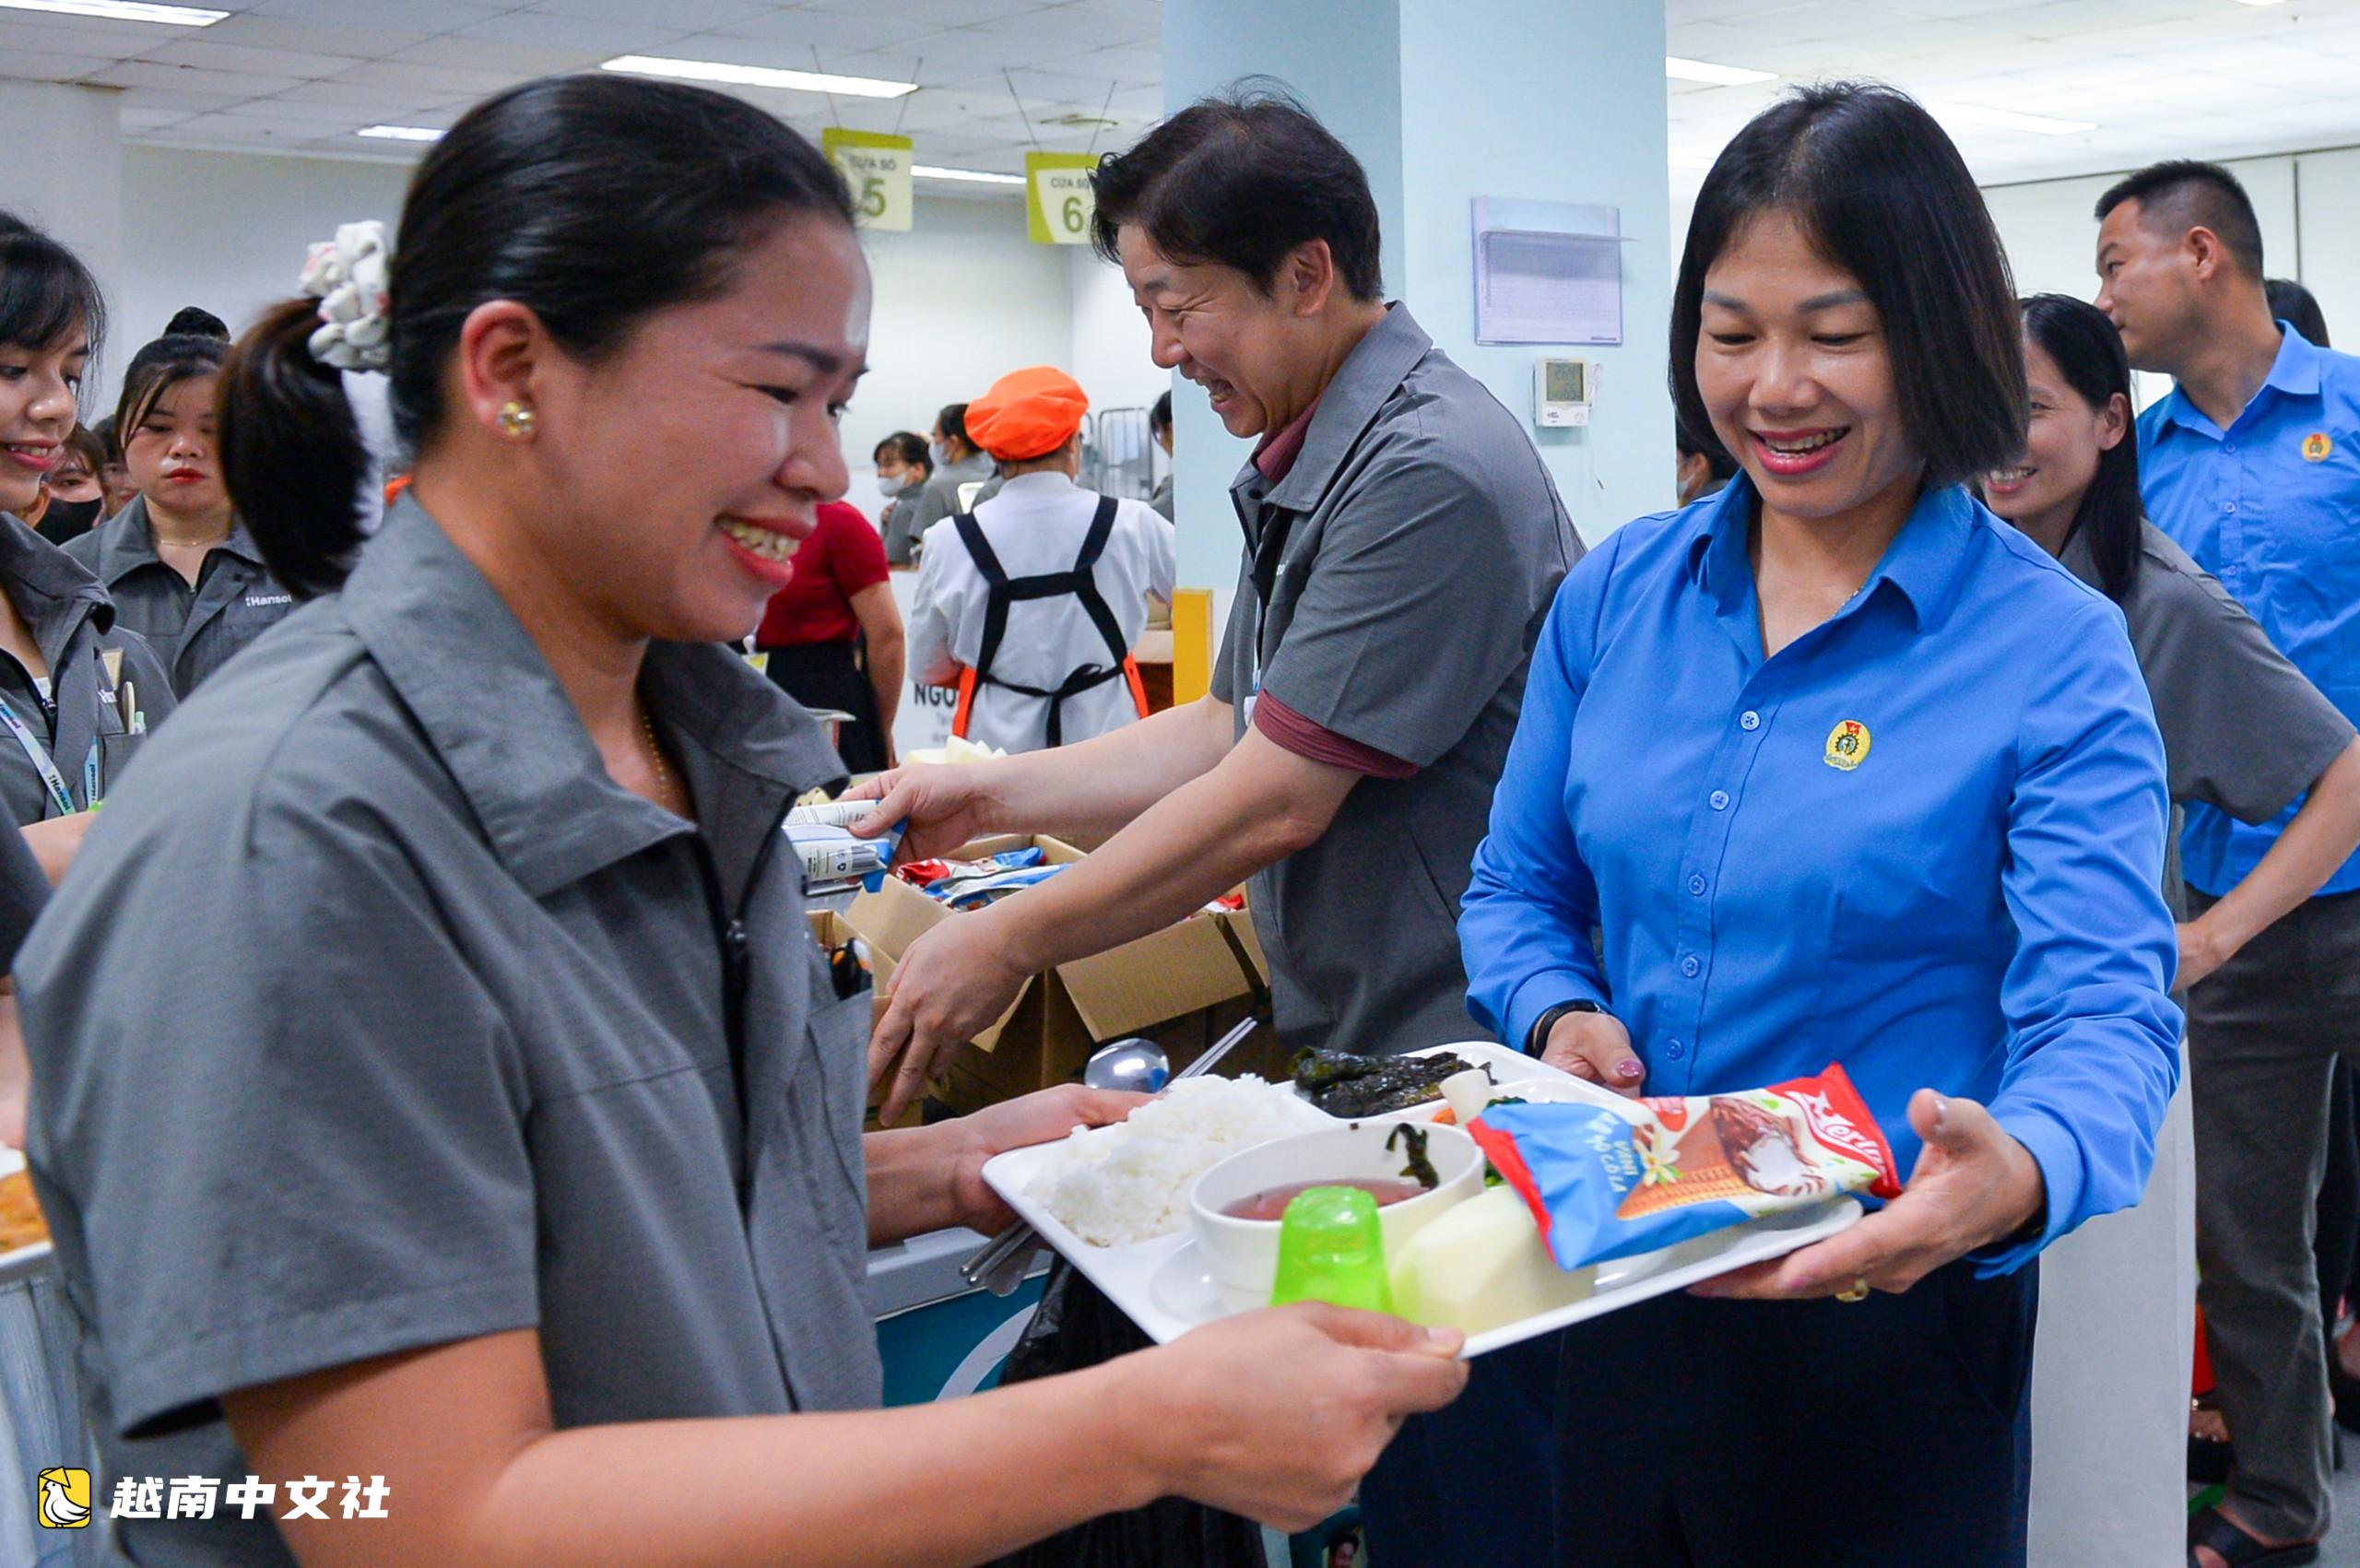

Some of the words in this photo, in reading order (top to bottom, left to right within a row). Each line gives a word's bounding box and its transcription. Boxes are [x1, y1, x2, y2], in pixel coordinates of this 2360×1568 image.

[863, 177, 887, 217] 5
[1063, 196, 1084, 233] 6
[250, 594, 292, 606] Hansol
[51, 777, 71, 811] Hansol
